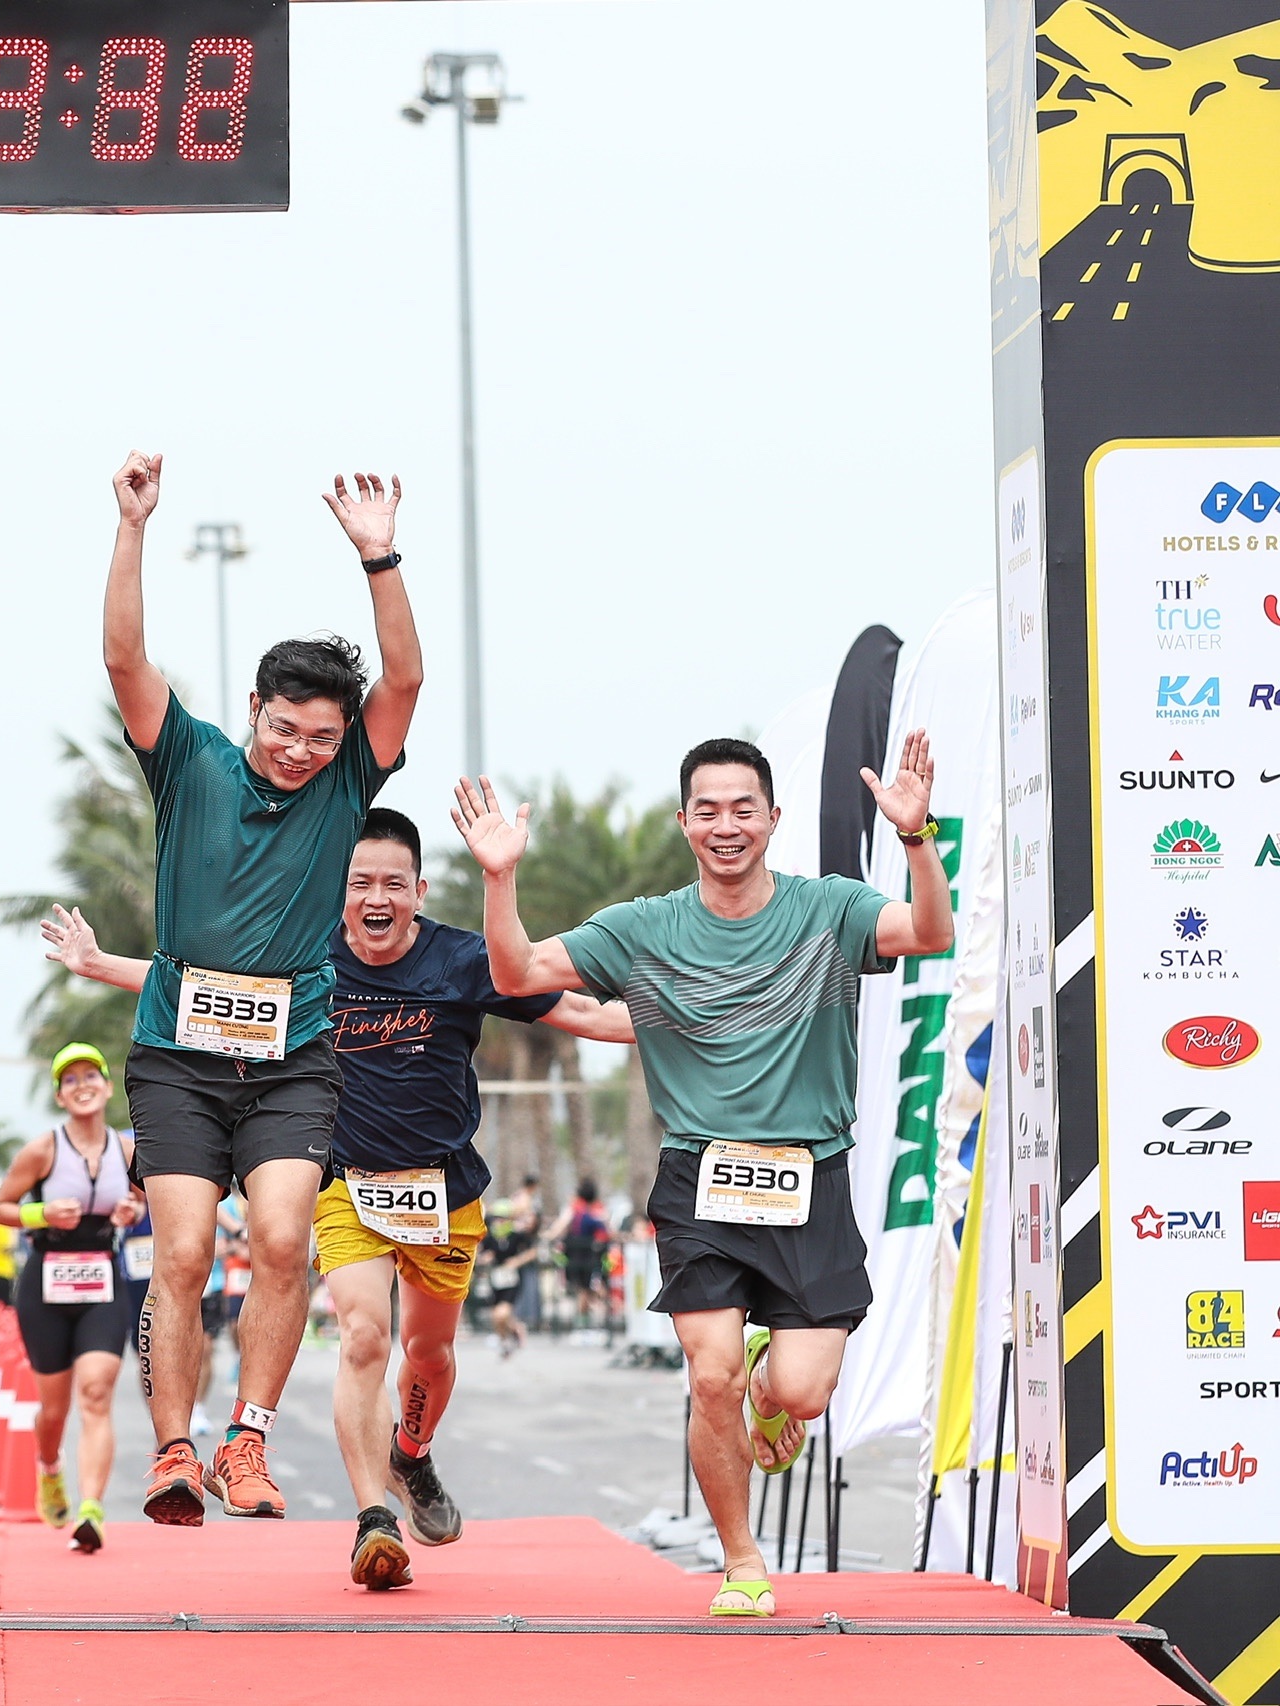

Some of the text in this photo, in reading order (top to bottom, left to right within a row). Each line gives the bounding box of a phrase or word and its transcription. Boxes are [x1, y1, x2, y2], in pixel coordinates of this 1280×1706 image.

[1163, 536, 1240, 551] HOTELS
[1246, 535, 1259, 550] &
[1155, 580, 1193, 600] TH
[1155, 603, 1222, 630] true
[1157, 634, 1222, 650] WATER
[1156, 676, 1220, 707] KA
[1156, 709, 1220, 719] KHANG AN
[1120, 769, 1235, 790] SUUNTO
[1154, 857, 1222, 865] HONG NGOC
[1164, 869, 1211, 884] Hospital
[1160, 950, 1223, 966] STAR
[1143, 970, 1239, 980] KOMBUCHA
[191, 992, 277, 1022] 5339
[328, 1004, 435, 1047] Finisher
[1182, 1020, 1242, 1062] Richy
[712, 1163, 799, 1192] 5330
[357, 1188, 436, 1211] 5340
[1167, 1210, 1220, 1229] PVI
[1167, 1230, 1227, 1239] INSURANCE
[1187, 1290, 1245, 1333] 84
[1188, 1332, 1244, 1347] RACE
[1160, 1442, 1258, 1486] ActiUp
